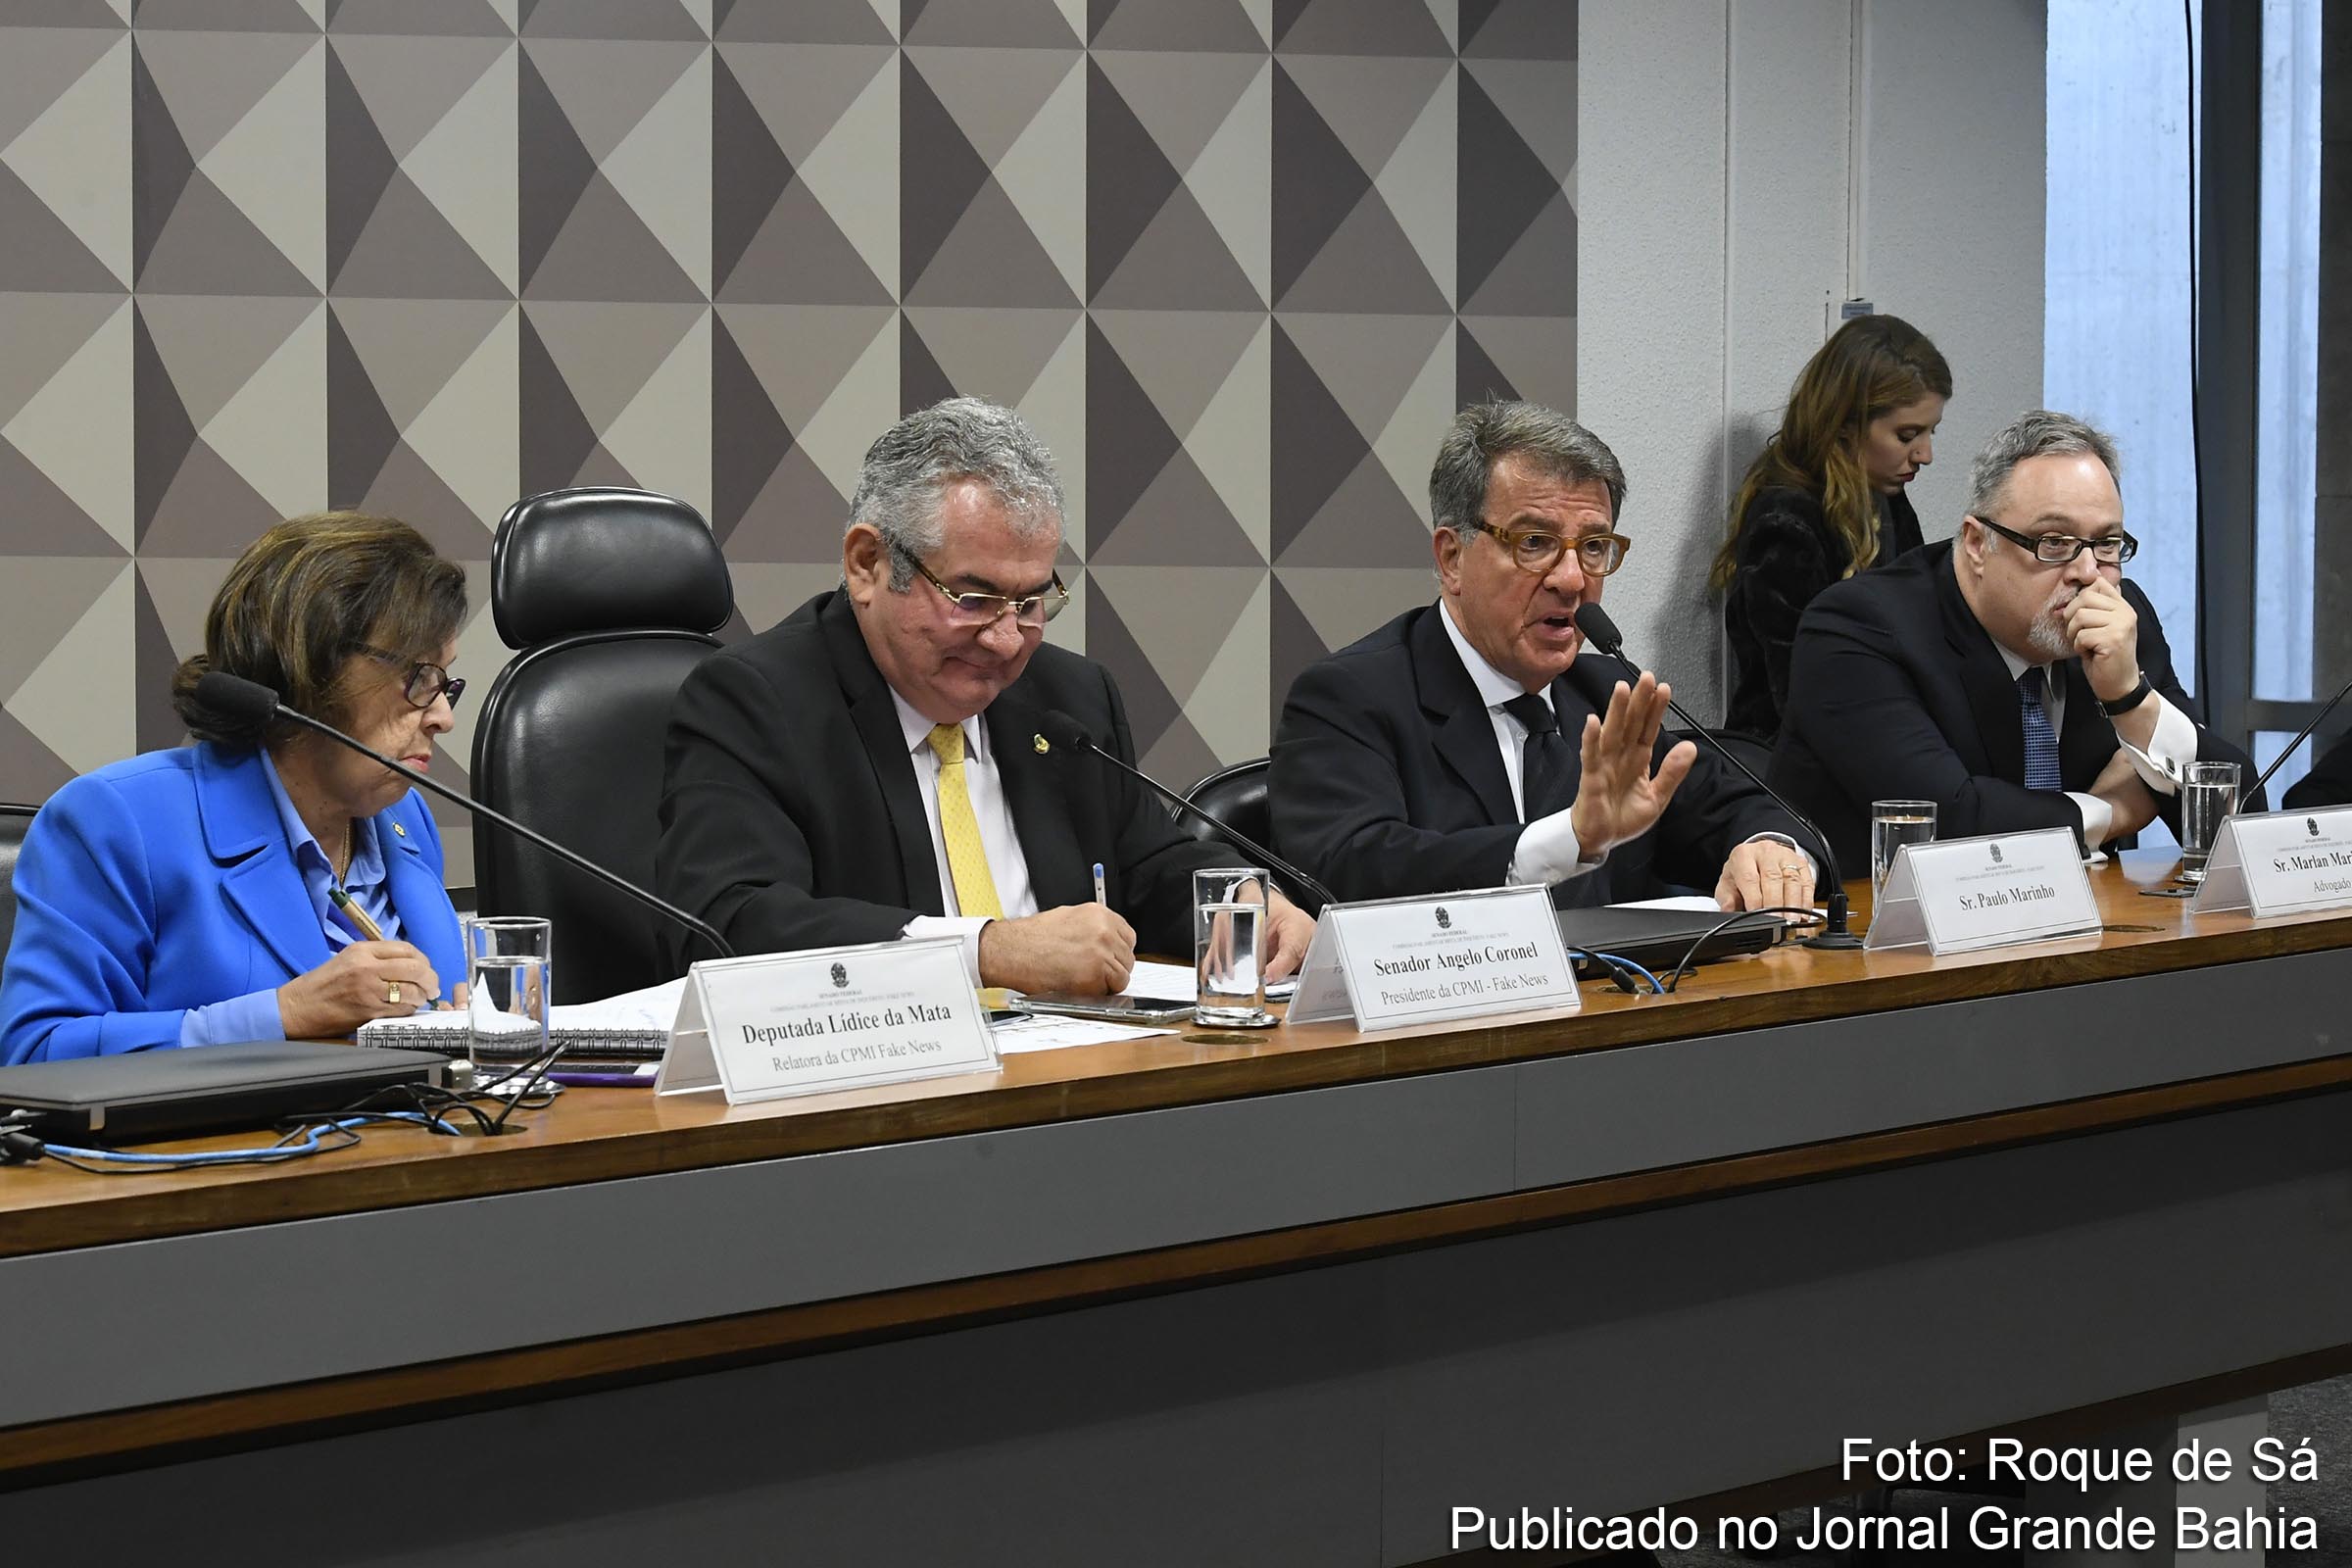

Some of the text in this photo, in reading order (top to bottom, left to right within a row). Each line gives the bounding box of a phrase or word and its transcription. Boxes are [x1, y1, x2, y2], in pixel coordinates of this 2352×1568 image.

[2273, 858, 2290, 873] Sr.
[2290, 854, 2329, 870] Marlan
[1959, 884, 2055, 911] Sr. Paulo Marinho
[2314, 877, 2352, 893] Advogado
[1373, 941, 1539, 977] Senador Angelo Coronel
[1381, 987, 1437, 1005] Presidente
[1438, 983, 1452, 999] da
[1453, 979, 1485, 997] CPMI
[1492, 975, 1518, 992] Fake
[1519, 973, 1549, 989] News
[741, 1004, 952, 1046] Deputada Lídice da Mata
[771, 1039, 942, 1072] Relatora da CPMI Fake News
